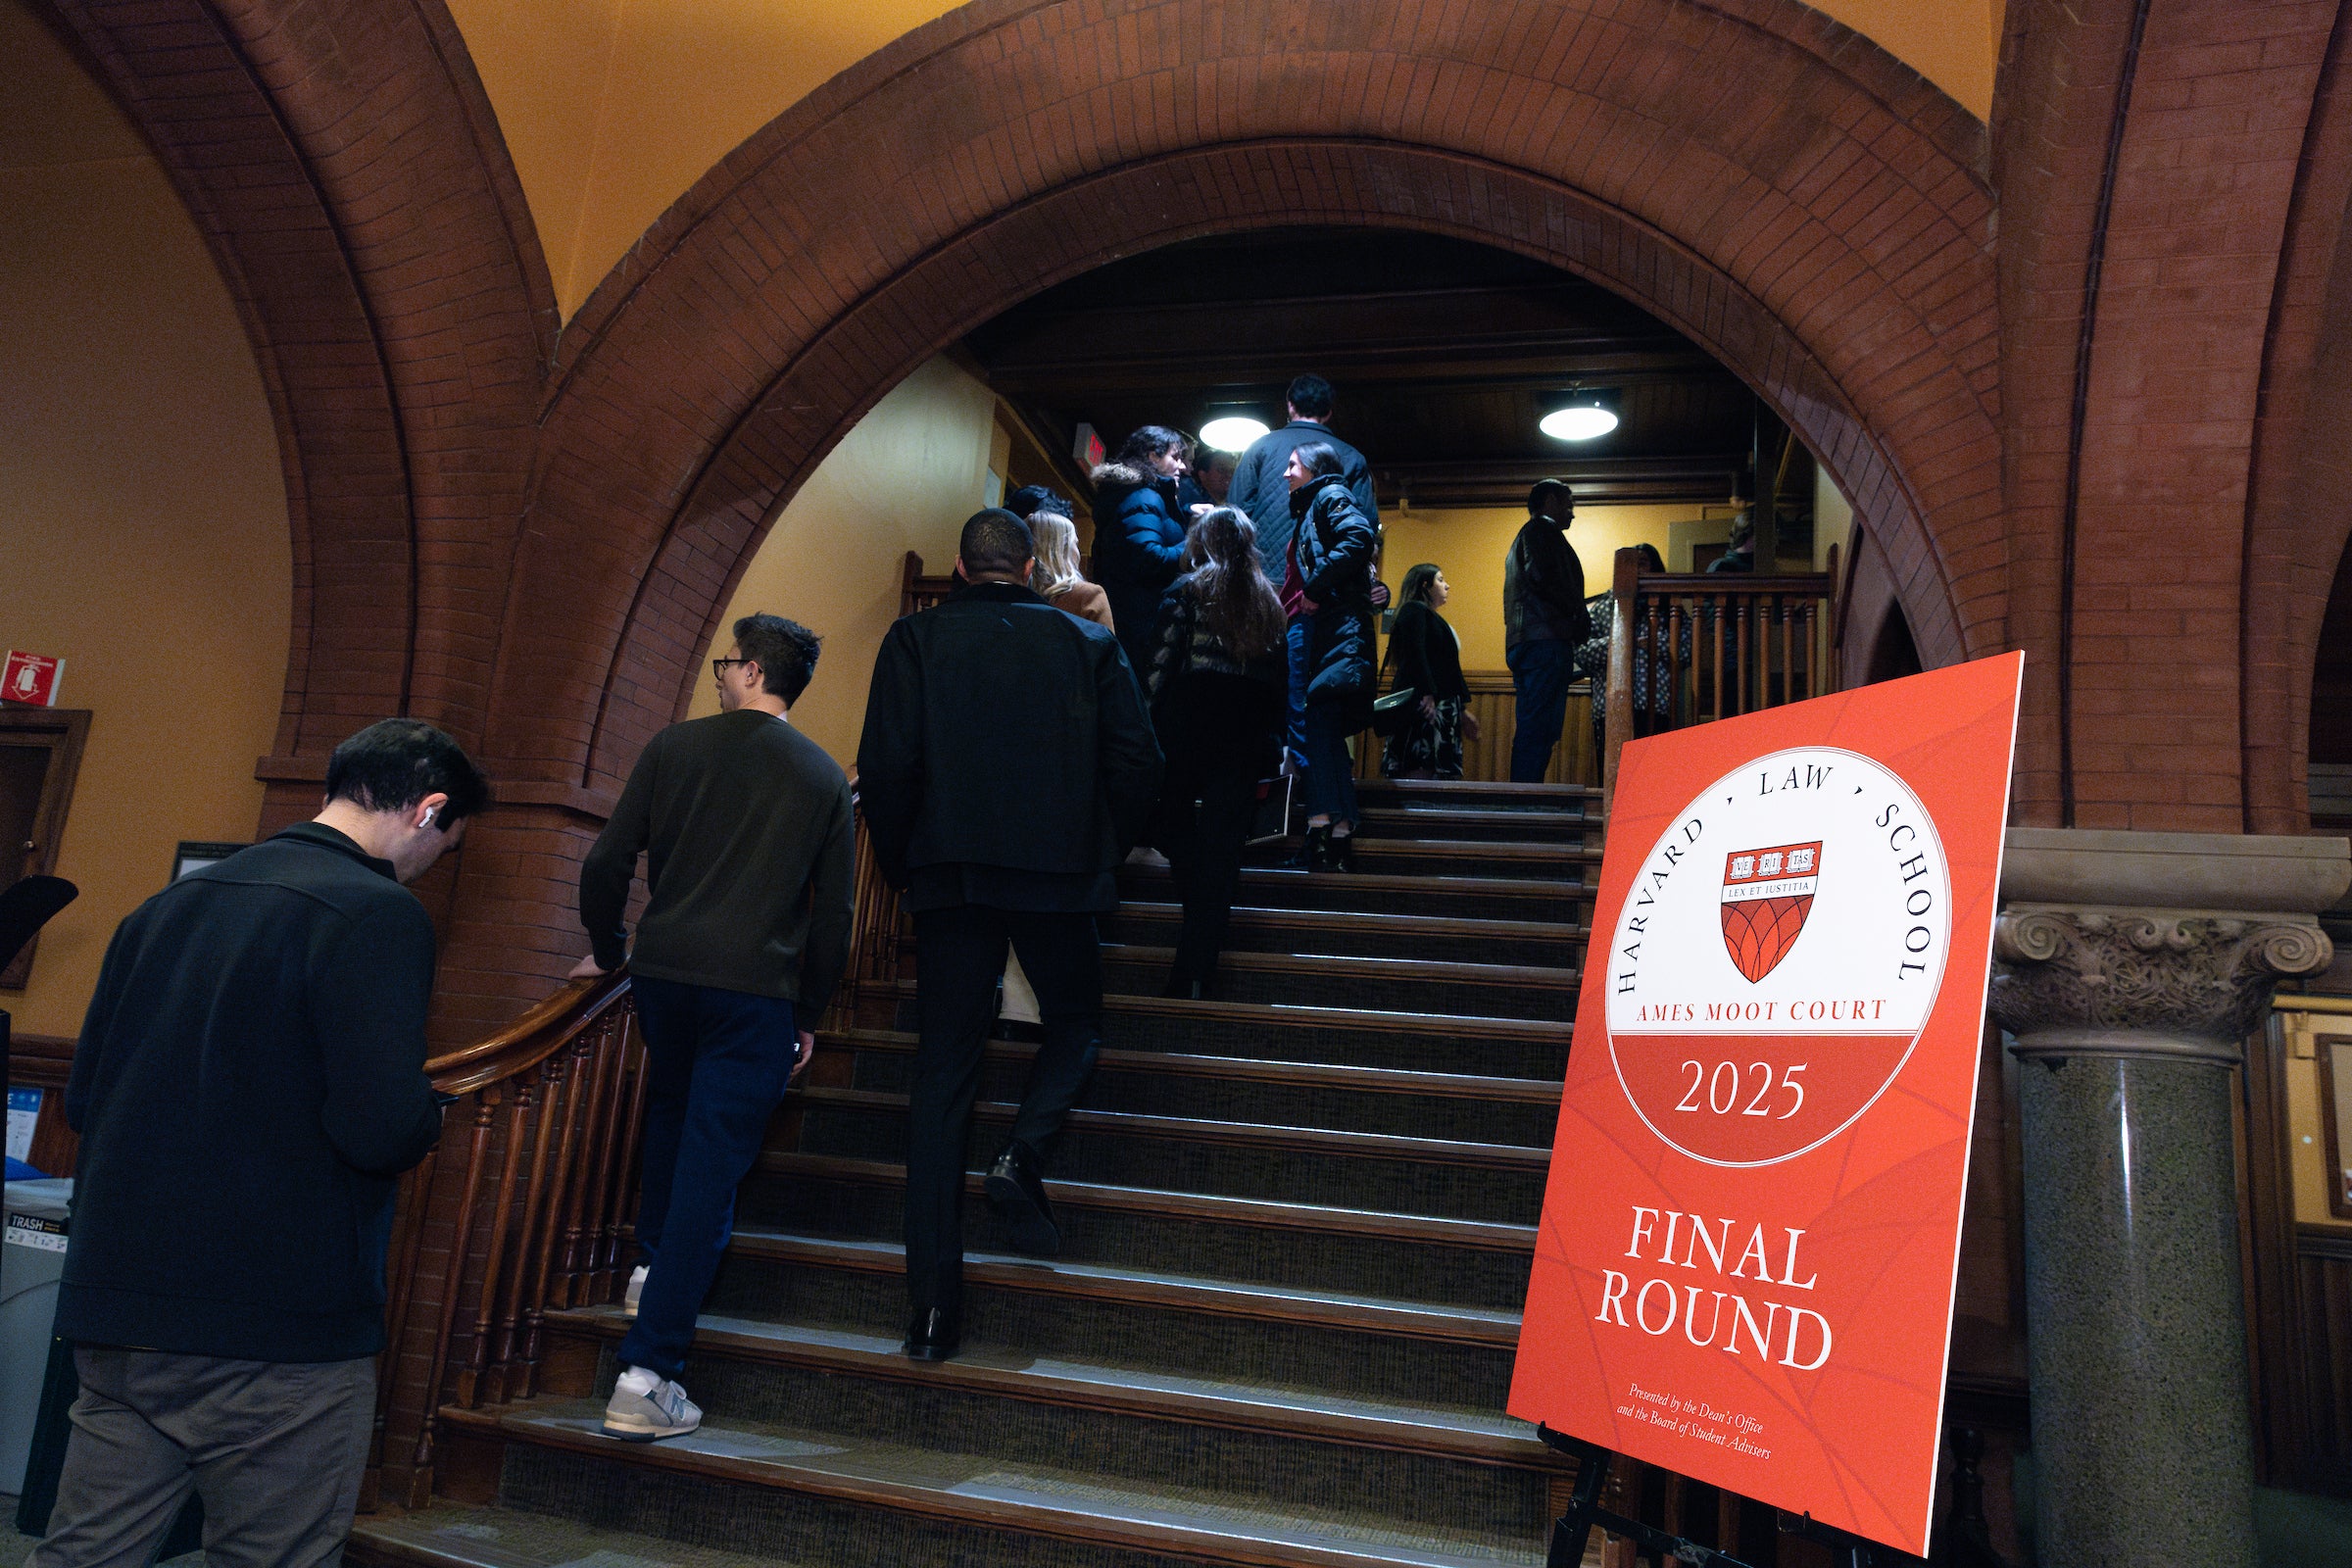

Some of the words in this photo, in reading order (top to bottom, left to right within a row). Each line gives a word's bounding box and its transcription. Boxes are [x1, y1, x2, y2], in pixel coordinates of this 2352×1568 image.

[1617, 818, 1703, 996] HARVARD
[1759, 764, 1834, 796] LAW
[1875, 804, 1932, 981] SCHOOL
[1728, 888, 1745, 898] LEX
[1749, 886, 1762, 896] ET
[1765, 882, 1809, 894] IUSTITIA
[1637, 1003, 1695, 1022] AMES
[1705, 1002, 1779, 1021] MOOT
[1789, 999, 1886, 1020] COURT
[1674, 1059, 1808, 1120] 2025
[12, 1214, 45, 1232] TRASH
[1624, 1205, 1818, 1291] FINAL
[1594, 1268, 1833, 1371] ROUND
[1617, 1403, 1634, 1418] and
[1634, 1406, 1649, 1422] the
[1649, 1410, 1679, 1431] Board
[1679, 1421, 1691, 1439] of
[1690, 1423, 1728, 1446] Student
[1727, 1437, 1772, 1460] Advisers
[1628, 1383, 1669, 1406] Presented
[1670, 1395, 1682, 1412] by
[1683, 1399, 1697, 1415] the
[1698, 1403, 1733, 1425] Dean's
[1735, 1413, 1764, 1435] Office
